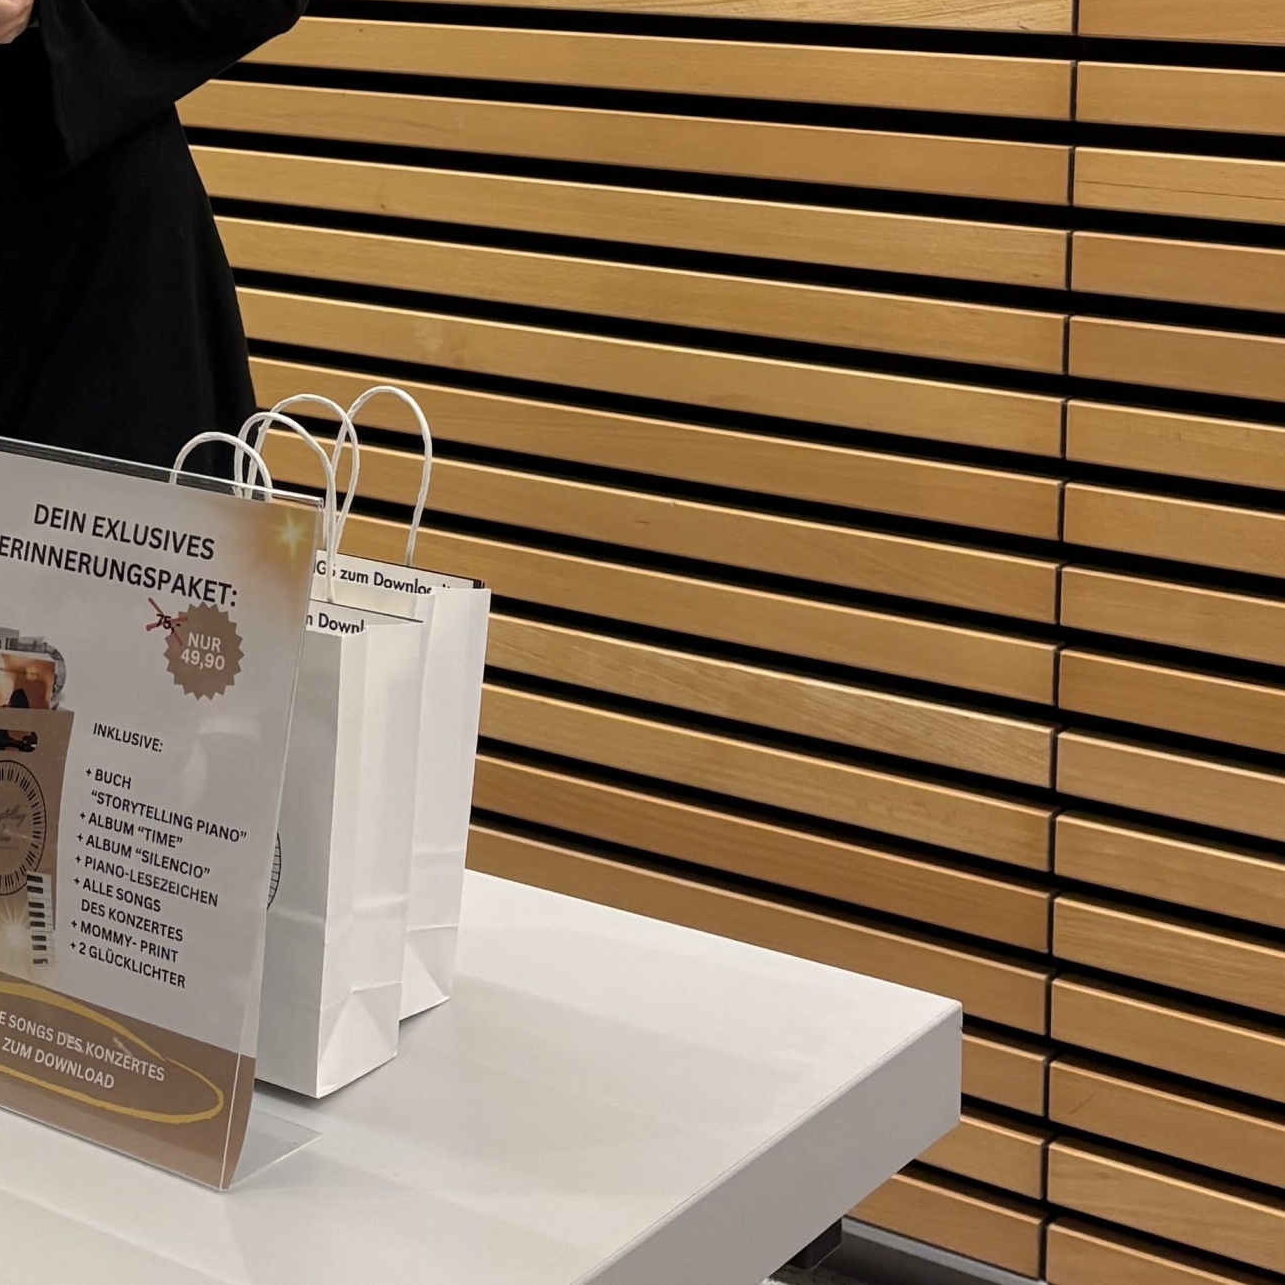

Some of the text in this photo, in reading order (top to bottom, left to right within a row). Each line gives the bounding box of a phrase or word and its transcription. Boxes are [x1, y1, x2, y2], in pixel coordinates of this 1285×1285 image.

[33, 503, 215, 560] DEIN EXLUSIVES
[340, 568, 369, 585] zum
[318, 612, 365, 634] Downl
[180, 648, 225, 671] 49,90
[187, 632, 222, 652] NUR
[93, 722, 164, 753] INKLUSIVE:
[94, 768, 132, 789] BUCH
[88, 812, 135, 837] ALBUM
[138, 825, 183, 849] “TIME”
[91, 789, 247, 843] “STORYTELLING PIANO”
[85, 834, 132, 859] ALBUM
[135, 847, 211, 879] “SILENCIO”
[82, 877, 114, 898] ALLE
[115, 888, 162, 913] SONGS
[84, 856, 219, 908] PIANO-LESEZEICHEN
[81, 899, 184, 942] DES KONZERTES
[78, 942, 86, 955] 2
[89, 945, 186, 989] GLÜCKLICHTER
[140, 940, 179, 963] PRINT
[1, 1037, 115, 1089] ZUM DOWNLOAD
[8, 1014, 55, 1042] SONGS
[57, 1032, 84, 1052] DES
[85, 1041, 166, 1082] KONZERTES
